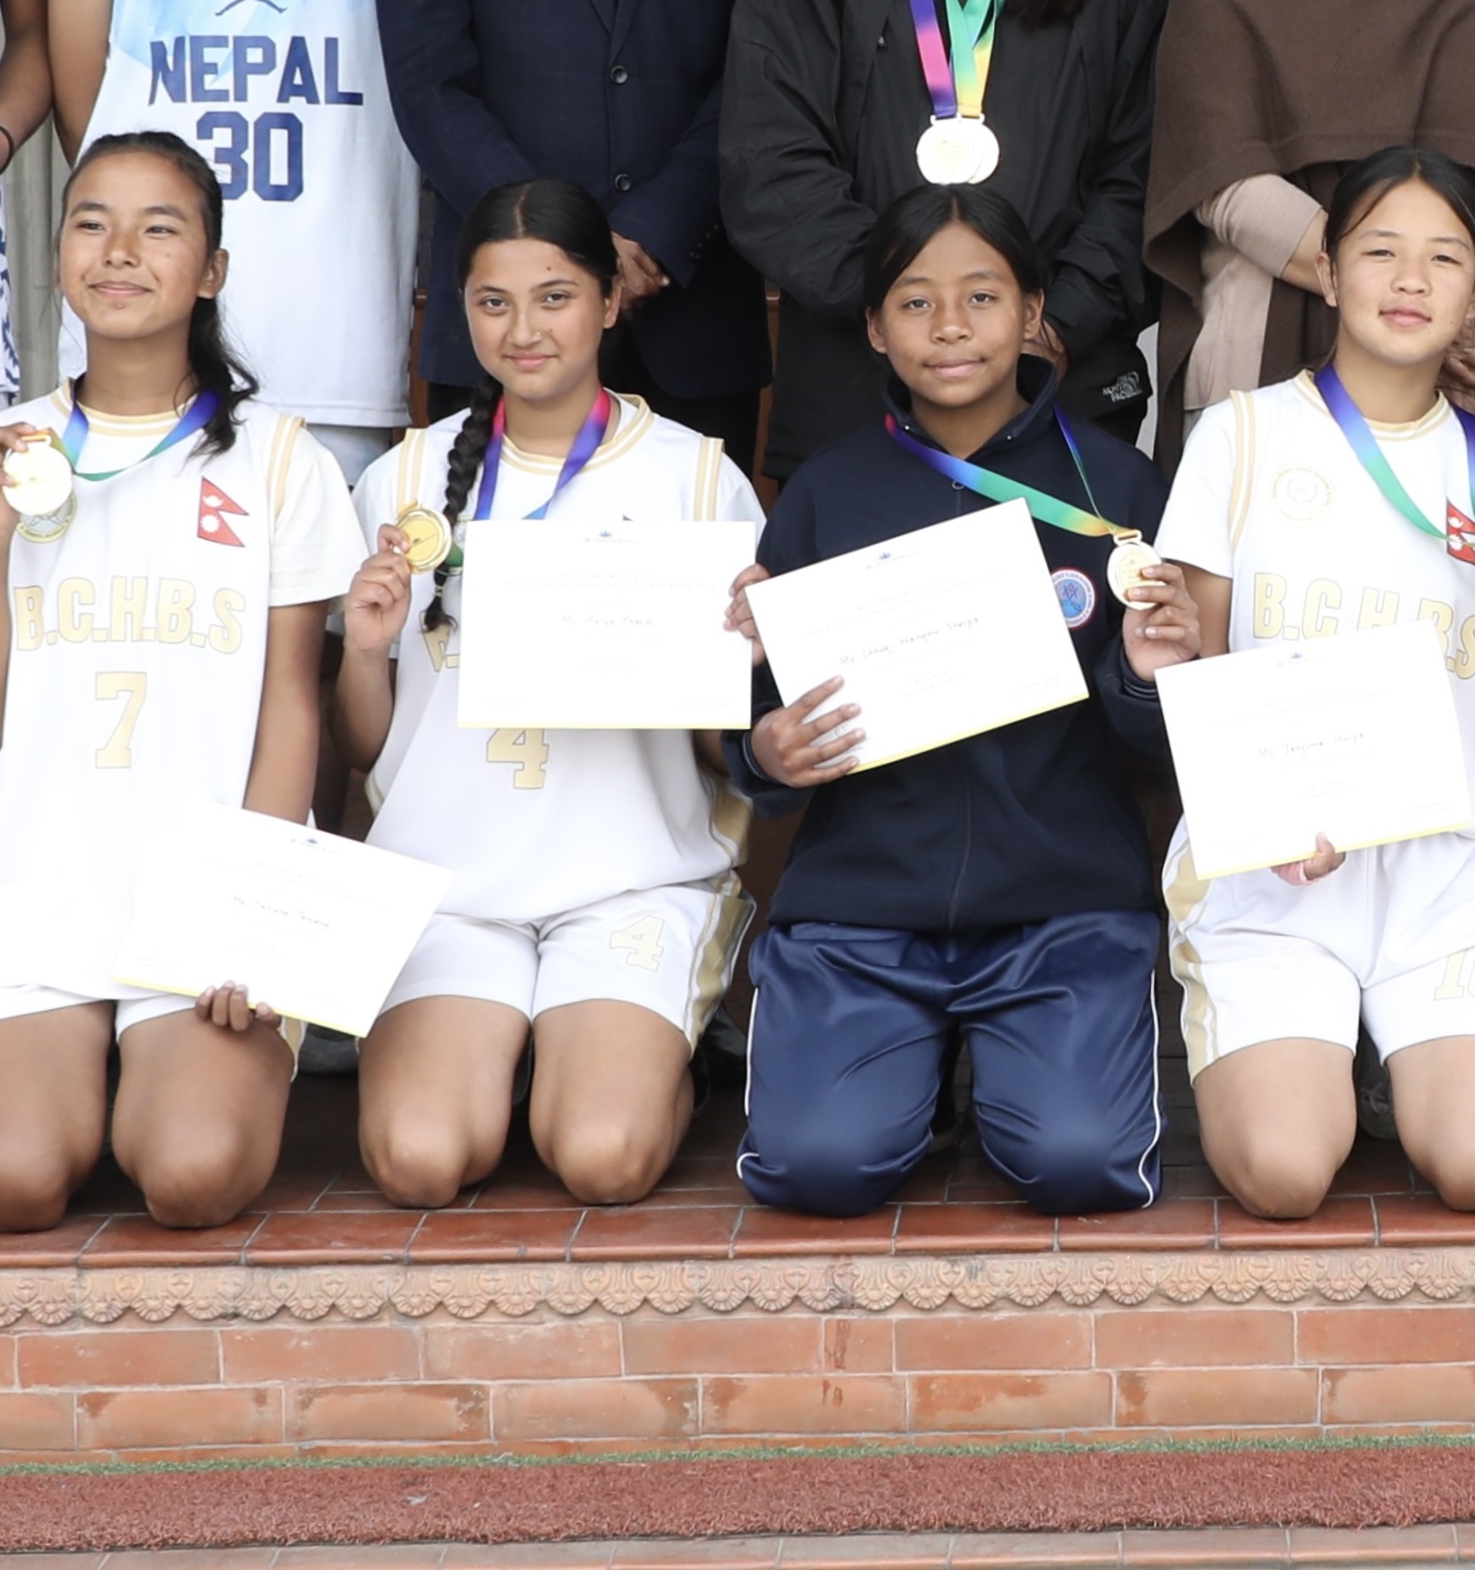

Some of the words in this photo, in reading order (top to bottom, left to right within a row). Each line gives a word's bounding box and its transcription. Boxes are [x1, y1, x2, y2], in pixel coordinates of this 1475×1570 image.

[149, 34, 364, 107] NEPAL
[197, 111, 304, 203] 30
[13, 576, 248, 654] B.C.H.B.S
[93, 670, 148, 769] 7
[486, 729, 550, 790] 4
[608, 914, 666, 973] 4
